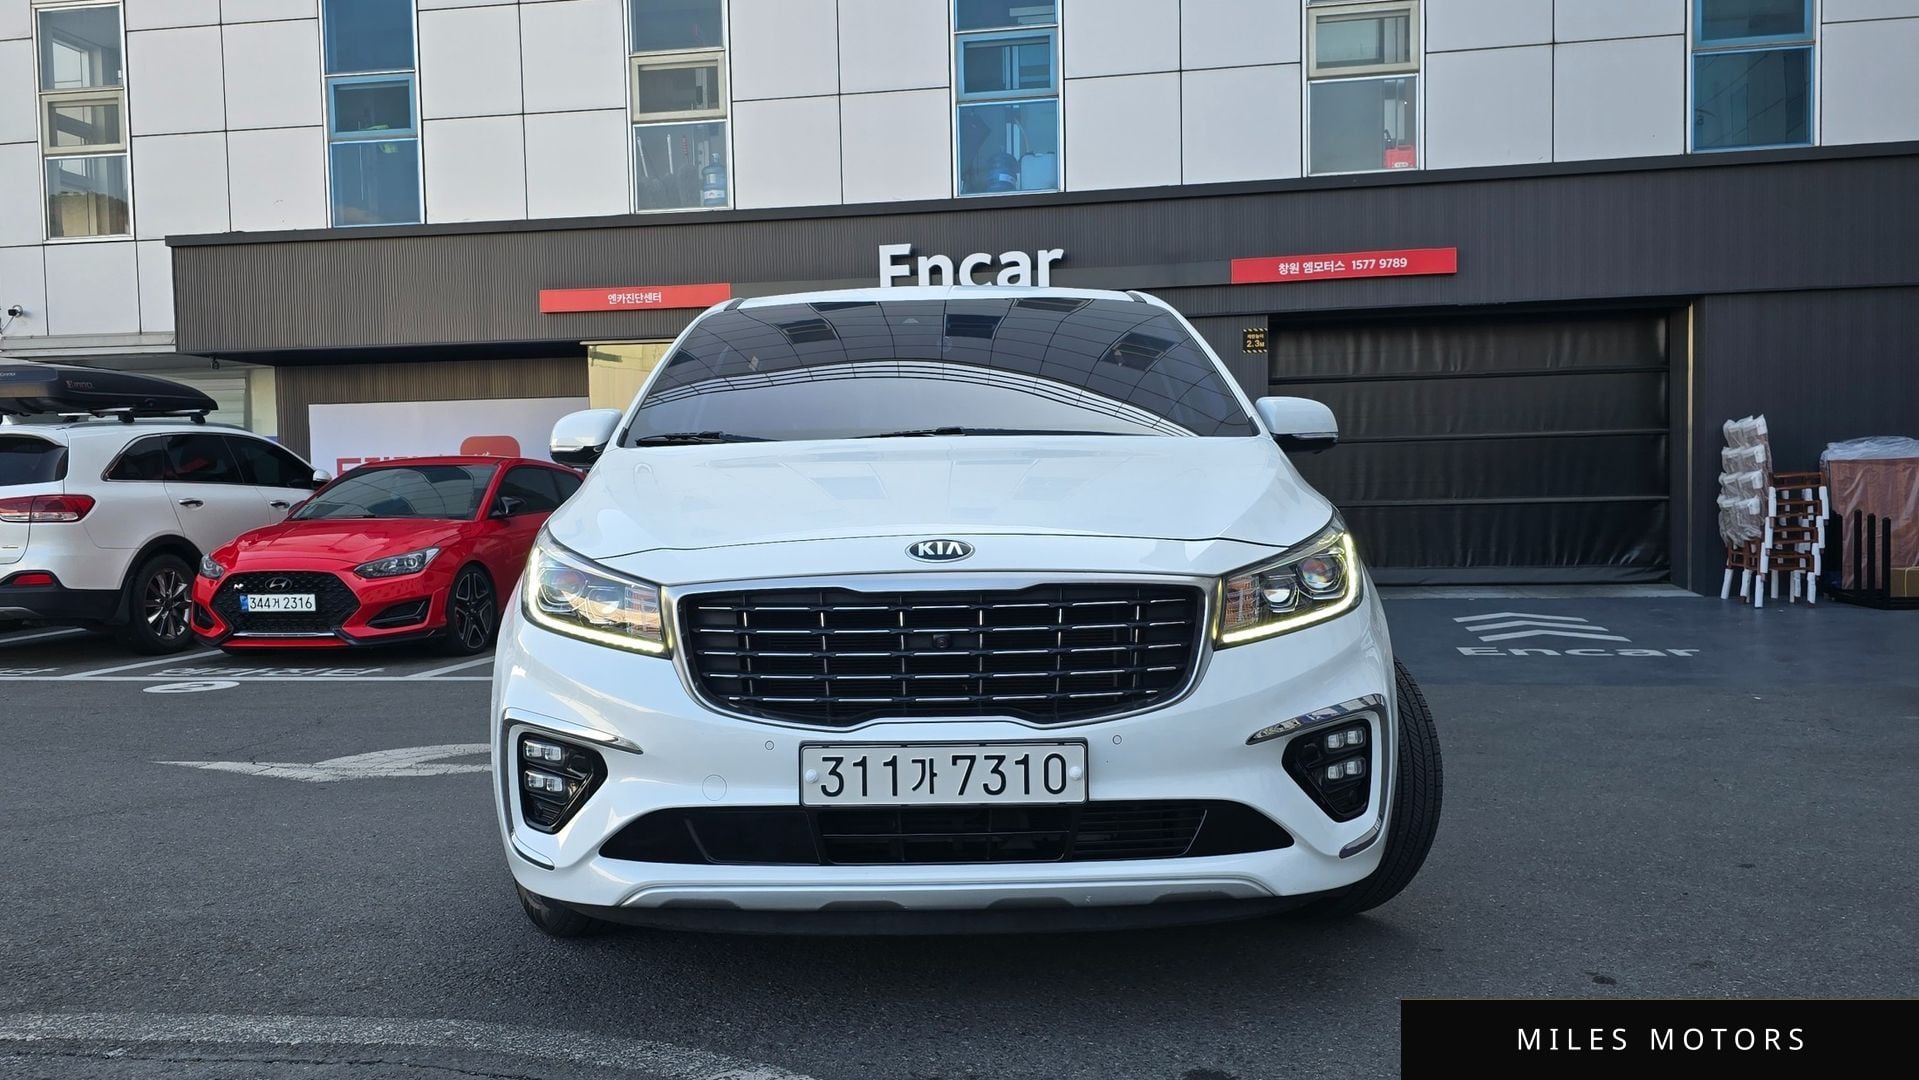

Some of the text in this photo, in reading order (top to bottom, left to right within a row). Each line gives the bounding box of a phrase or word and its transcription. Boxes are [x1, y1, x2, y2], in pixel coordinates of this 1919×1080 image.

[1278, 262, 1300, 276] 창원
[1351, 259, 1376, 271] 1577
[1379, 257, 1408, 269] 9789
[607, 291, 662, 305] 엔카진단센터
[918, 541, 964, 556] KIA
[249, 597, 280, 609] 344거
[283, 596, 313, 609] 2316
[1455, 646, 1700, 657] Encar
[820, 753, 1068, 797] 311가 7310
